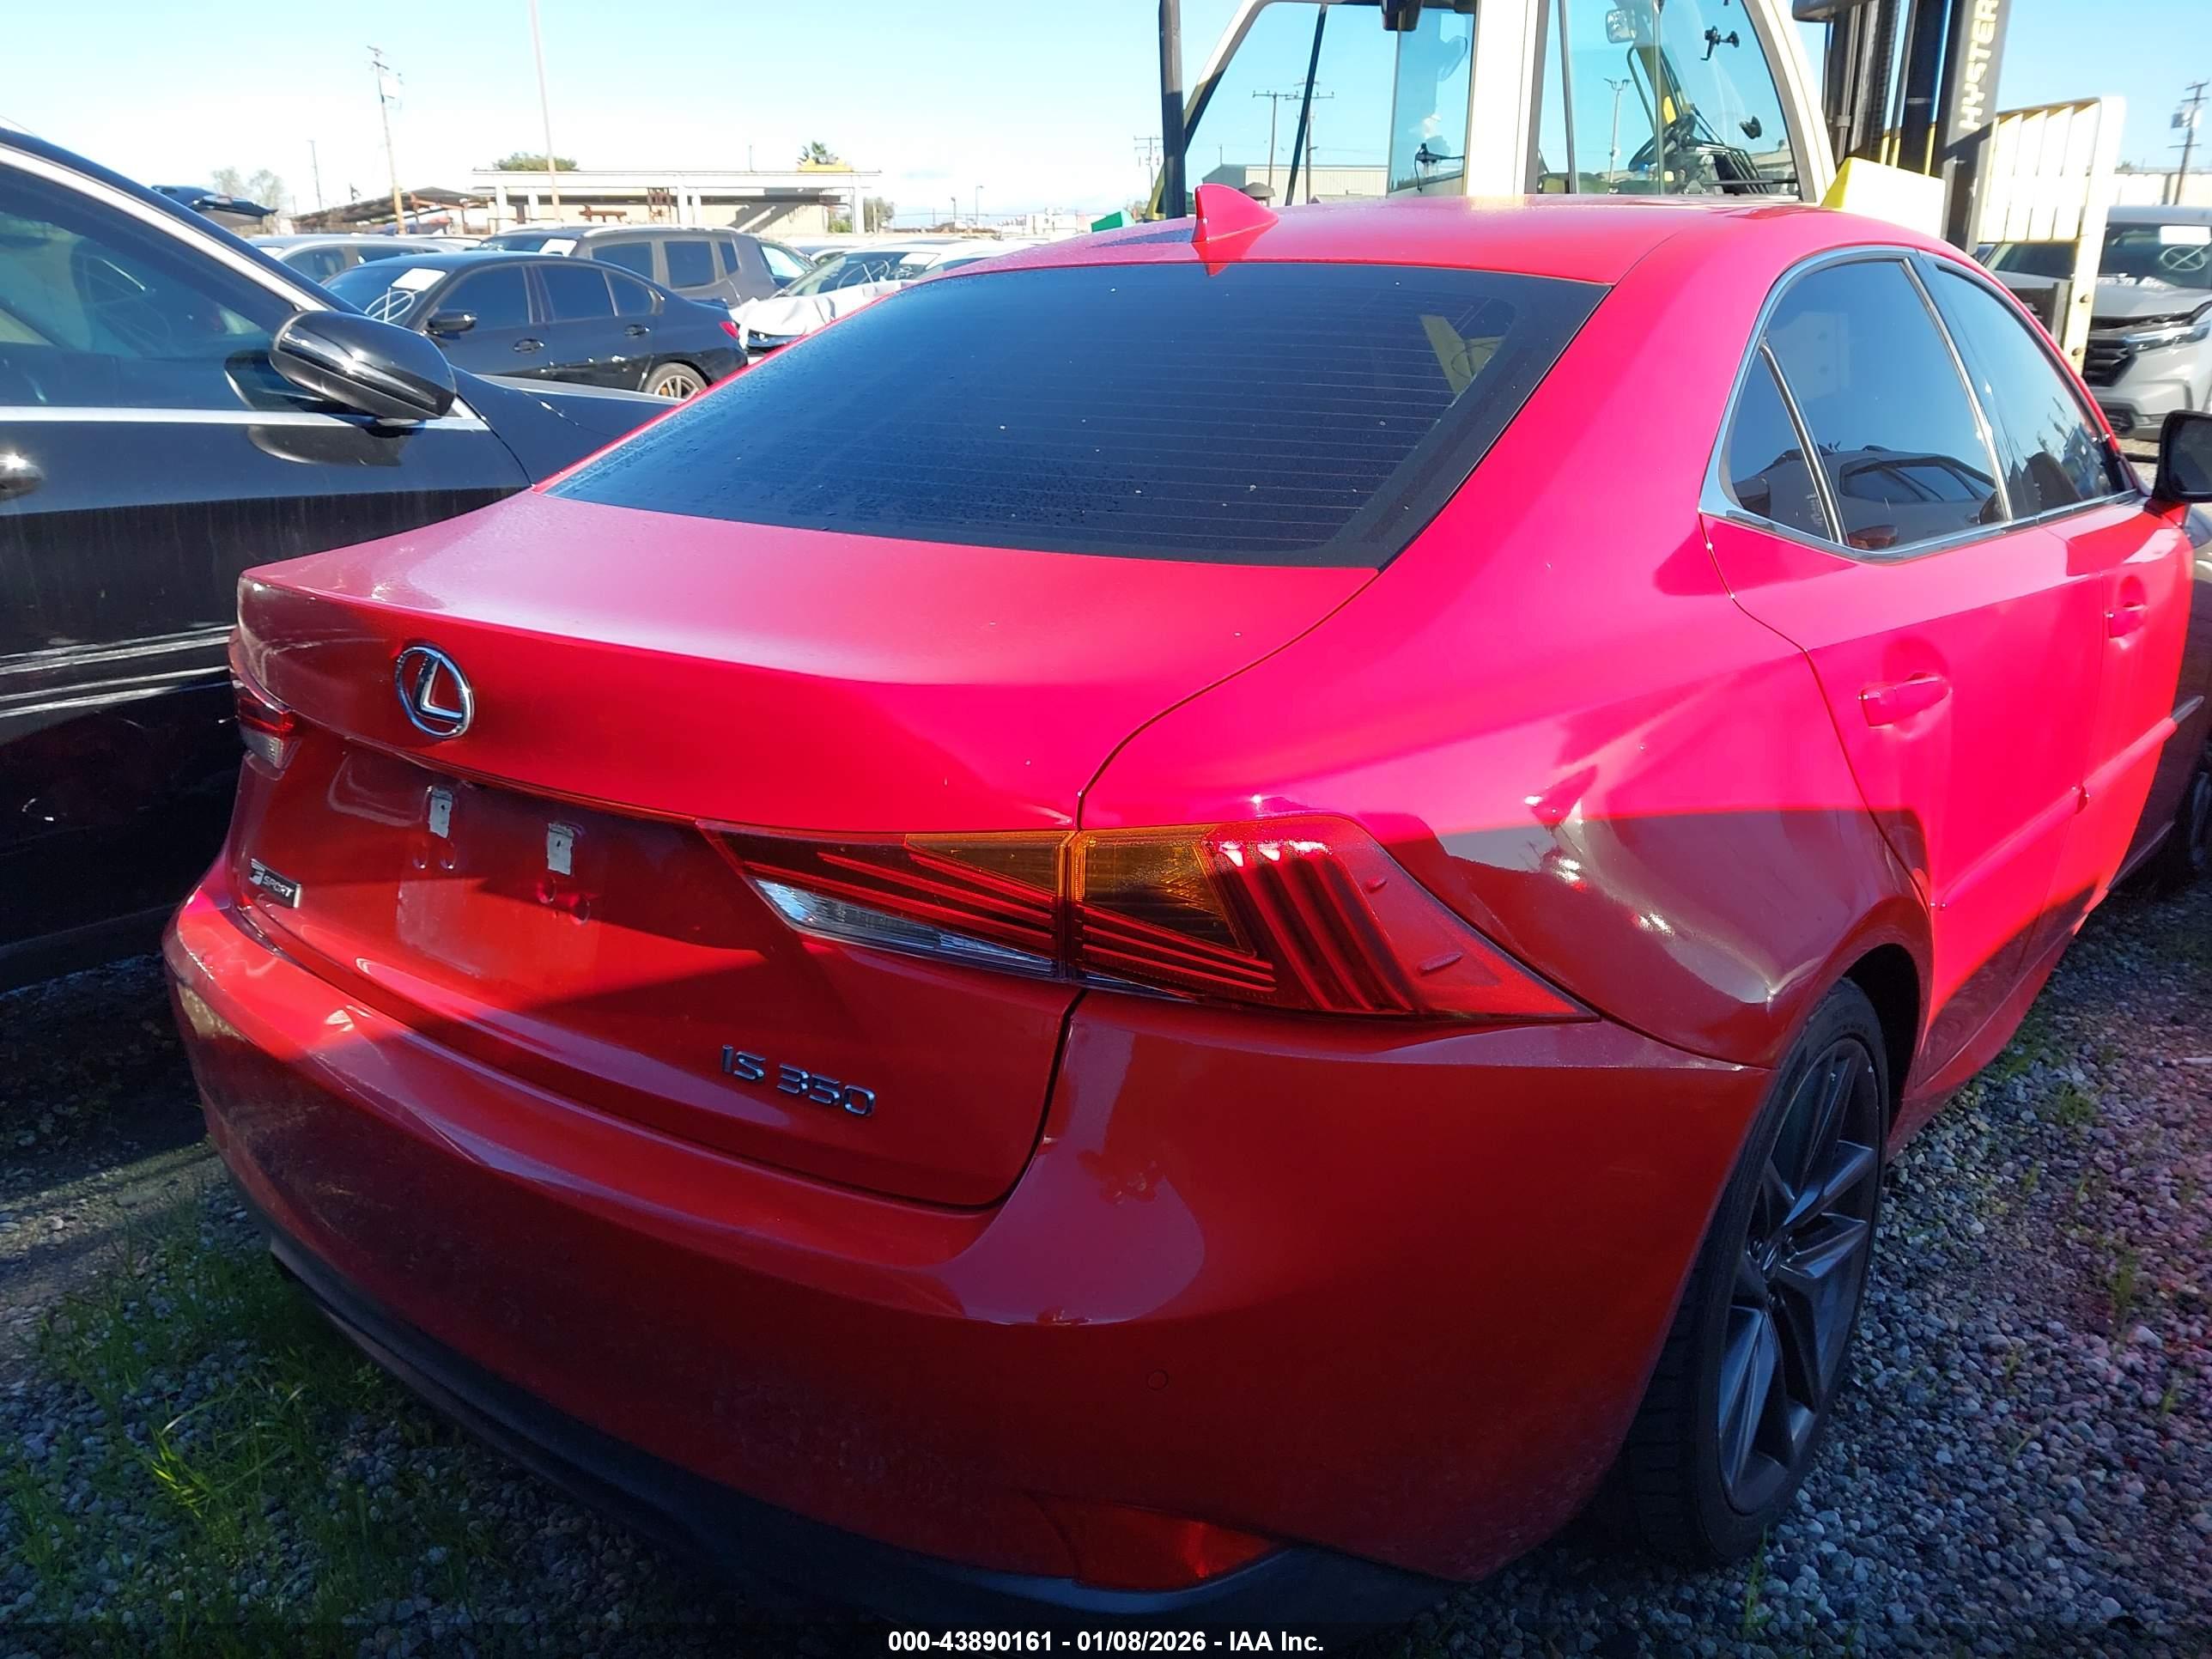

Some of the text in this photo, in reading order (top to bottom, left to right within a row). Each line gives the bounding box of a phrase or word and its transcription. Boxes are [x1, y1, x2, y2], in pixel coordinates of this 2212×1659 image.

[1959, 0, 1999, 131] HYSTER
[262, 875, 295, 898] SPORT
[721, 1044, 876, 1115] IS 350
